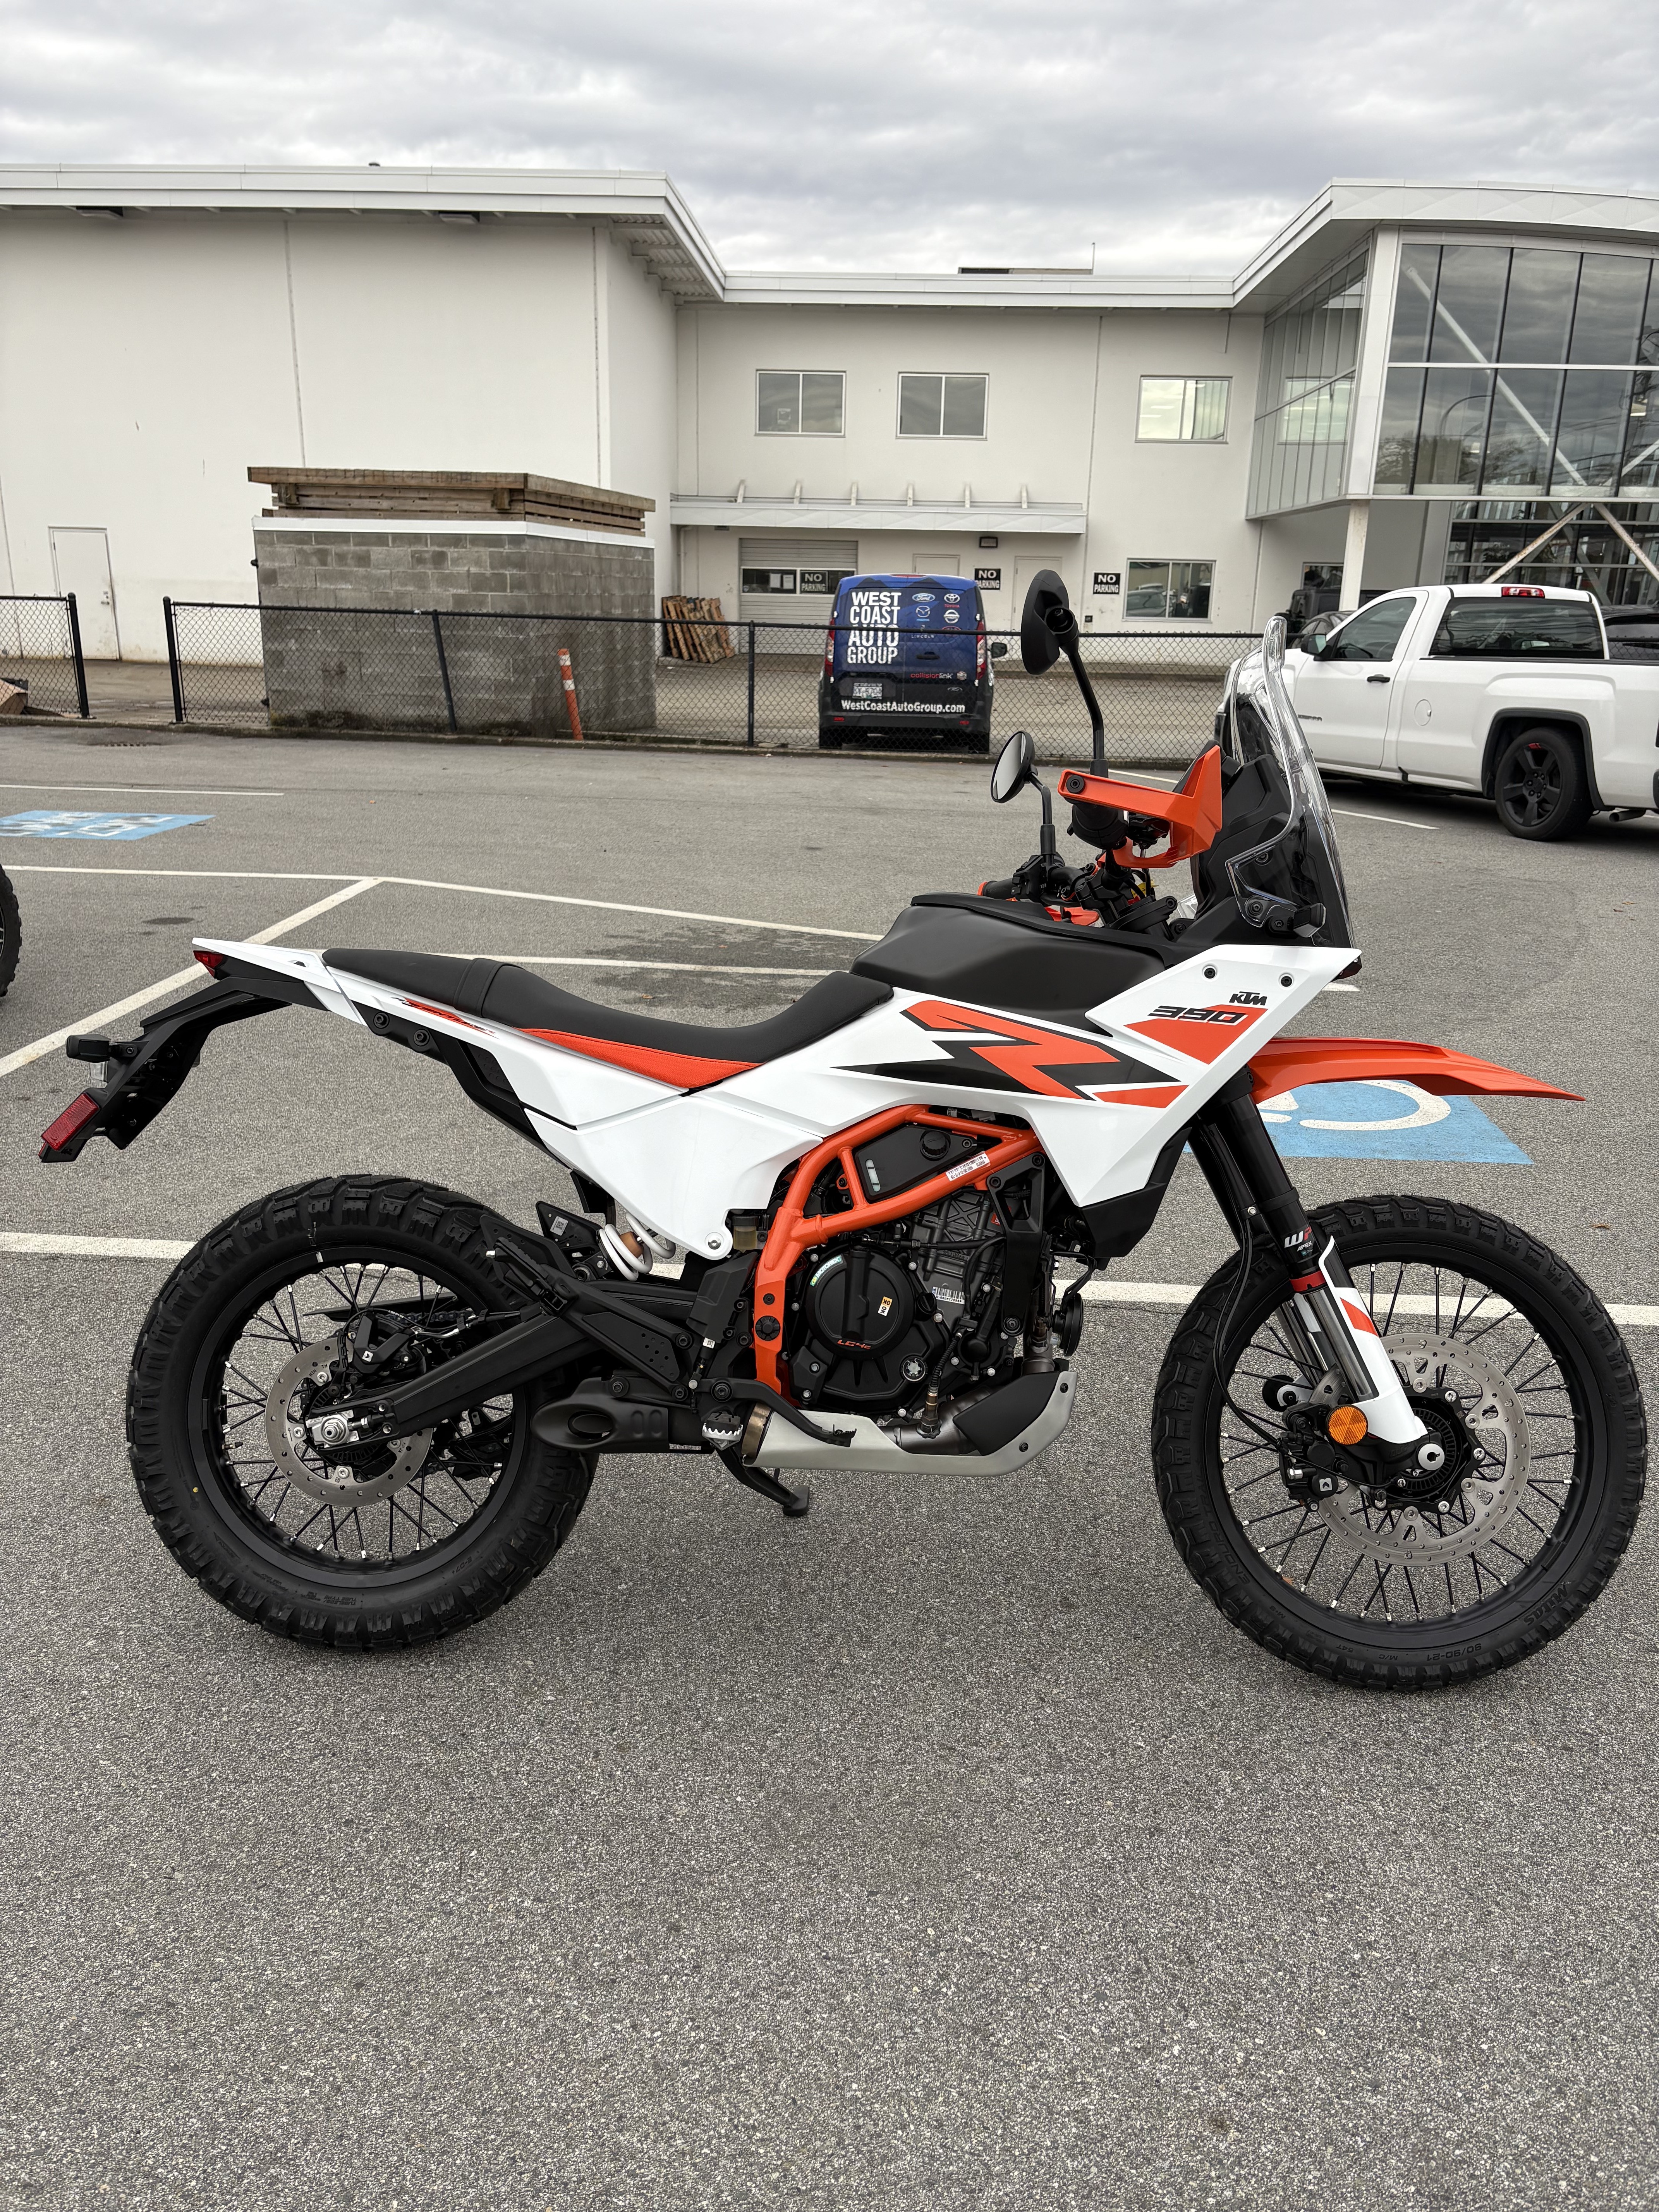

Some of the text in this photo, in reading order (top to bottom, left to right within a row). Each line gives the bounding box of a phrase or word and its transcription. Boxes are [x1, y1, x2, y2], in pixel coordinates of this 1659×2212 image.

[805, 574, 822, 582] NO
[1098, 574, 1116, 583] NO
[1094, 584, 1119, 592] PARKING
[852, 592, 902, 606] WEST
[850, 606, 901, 624] COAST
[848, 624, 899, 647] AUTO
[847, 647, 898, 664] GROUP
[841, 700, 965, 714] WestCoastAutoGroup.com
[1229, 991, 1267, 1006] KTM
[1147, 1005, 1248, 1026] 390
[815, 1255, 842, 1279] MOTOREX
[880, 1306, 887, 1314] OK
[309, 1369, 317, 1377] MIN
[1209, 1520, 1251, 1585] ENDURO
[1523, 1583, 1569, 1626] Mitas
[1336, 1643, 1354, 1653] 54T
[1425, 1642, 1482, 1661] 90/90-21
